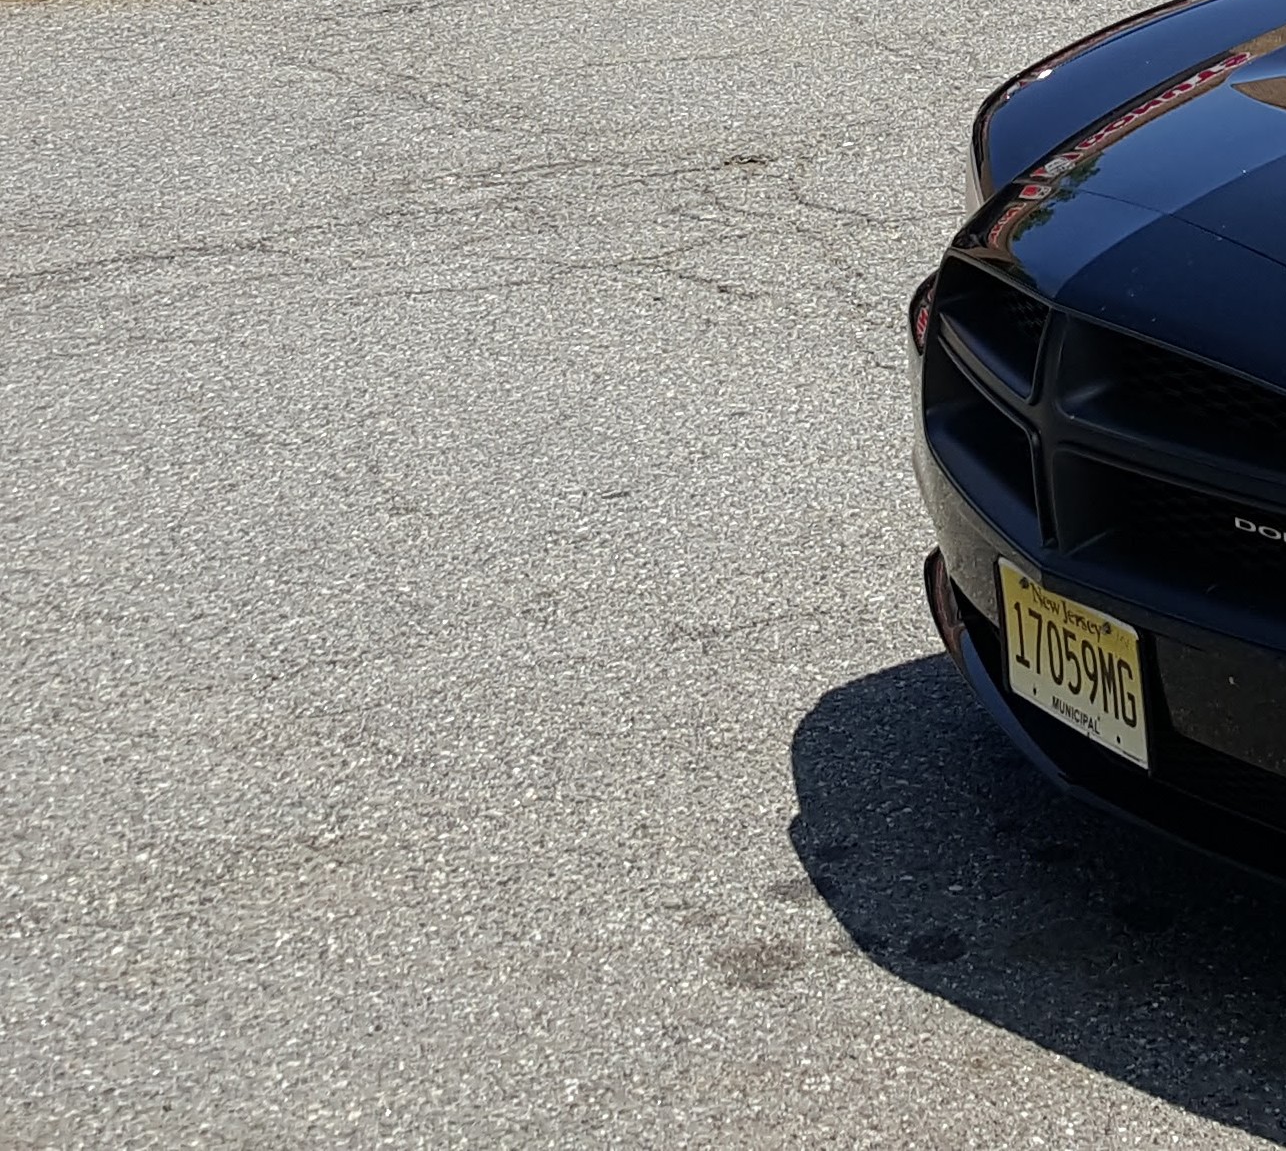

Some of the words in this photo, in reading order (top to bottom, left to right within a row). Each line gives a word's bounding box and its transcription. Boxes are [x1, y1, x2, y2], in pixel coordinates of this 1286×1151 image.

[1030, 582, 1061, 614] New
[1063, 601, 1104, 644] Jersey
[1013, 600, 1138, 730] 17059MG
[1052, 695, 1101, 735] MUNICIPAL
